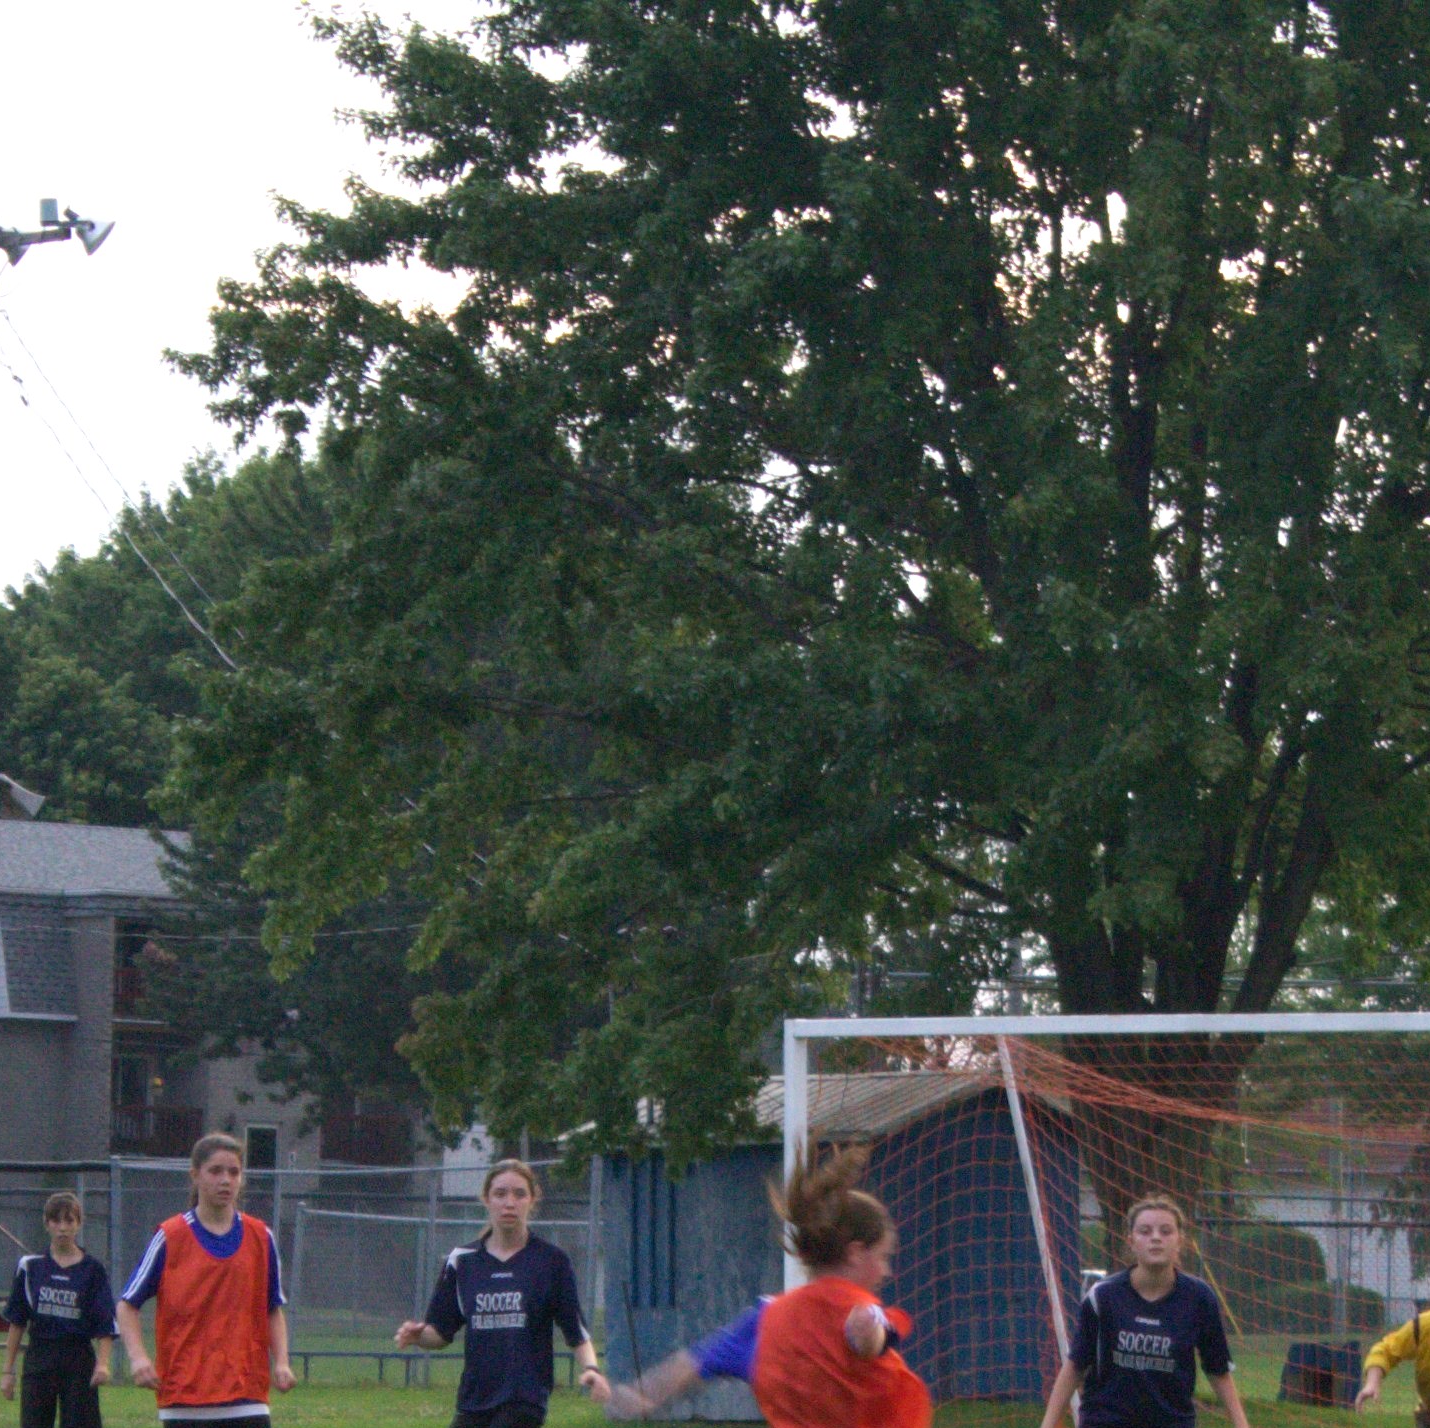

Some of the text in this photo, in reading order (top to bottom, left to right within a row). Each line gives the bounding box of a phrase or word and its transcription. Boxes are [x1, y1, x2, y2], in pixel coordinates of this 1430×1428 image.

[38, 1286, 77, 1305] SOCCER
[475, 1292, 522, 1312] SOCCER
[1117, 1330, 1171, 1357] SOCCER
